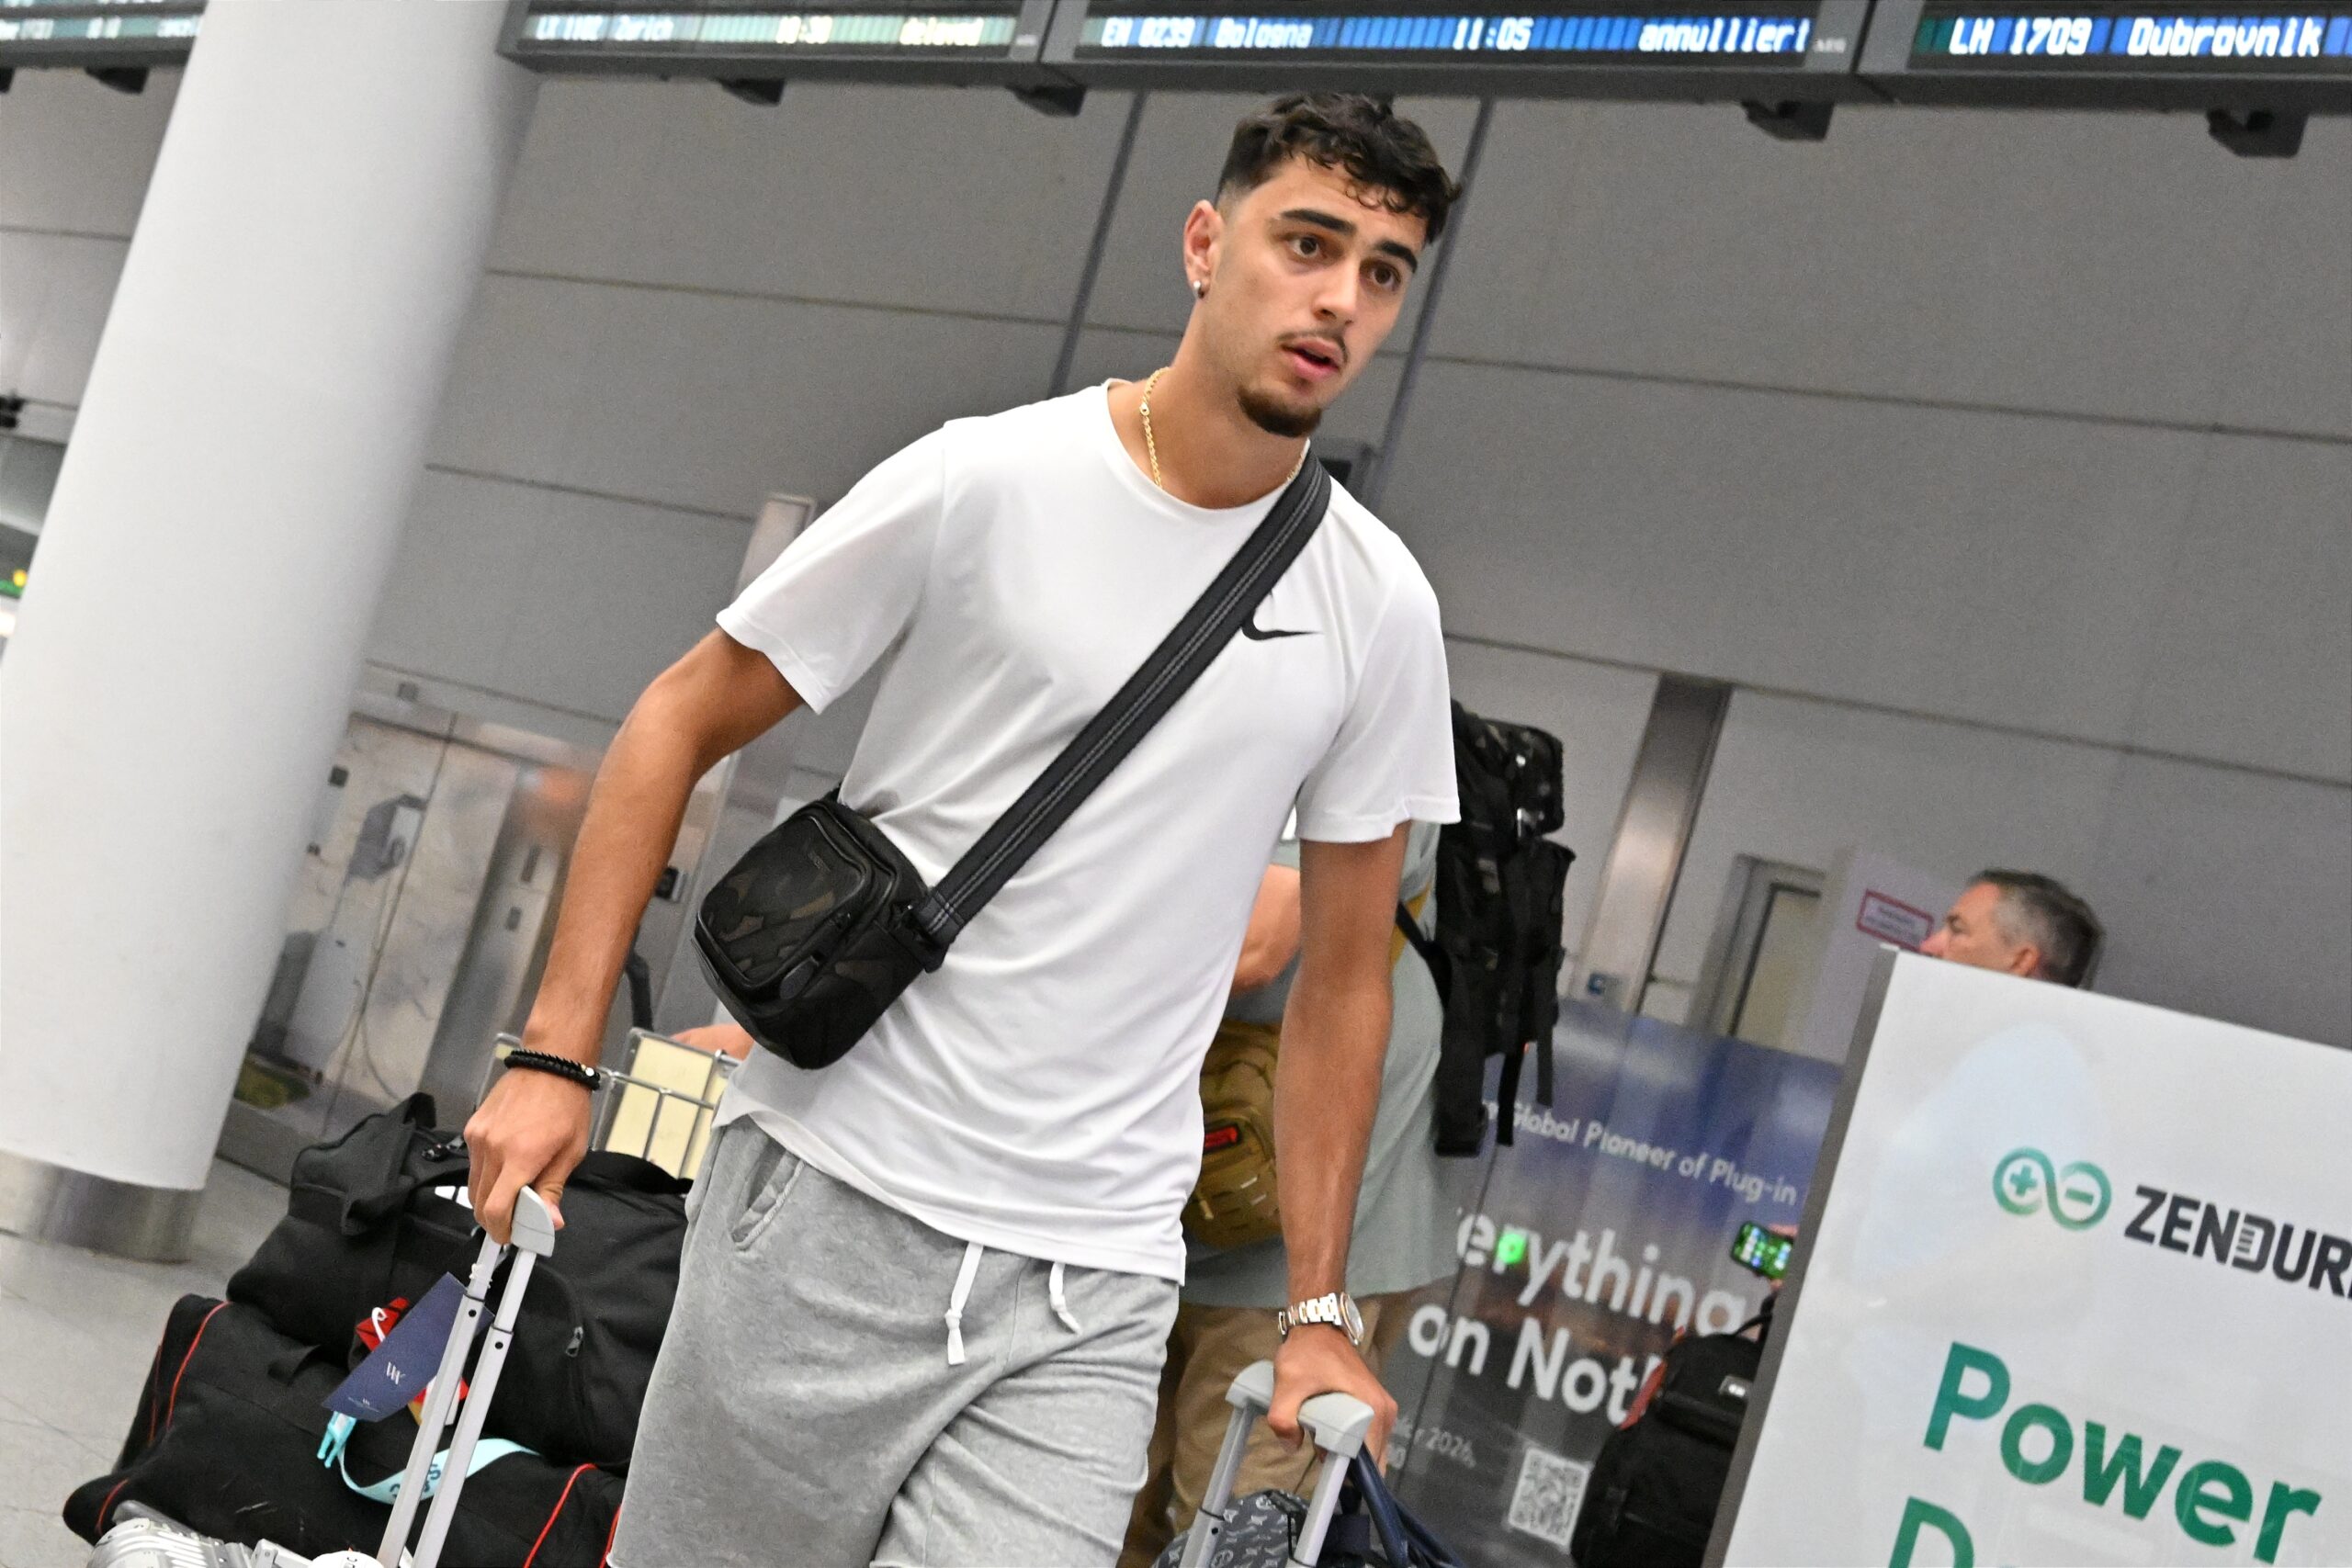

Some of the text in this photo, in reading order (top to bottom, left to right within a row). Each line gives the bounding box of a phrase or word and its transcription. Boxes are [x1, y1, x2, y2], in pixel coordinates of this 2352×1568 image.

[1215, 17, 1314, 49] Bologna
[1453, 17, 1534, 51] 11:05
[1949, 17, 2323, 57] LH 1709 Dubrovnik
[1583, 1119, 1676, 1171] Pioneer
[1679, 1153, 1708, 1179] of
[1709, 1156, 1797, 1206] Plug-in
[2124, 1185, 2352, 1301] ZENDUR
[1408, 1303, 1664, 1427] on Not
[1922, 1340, 2324, 1566] Power
